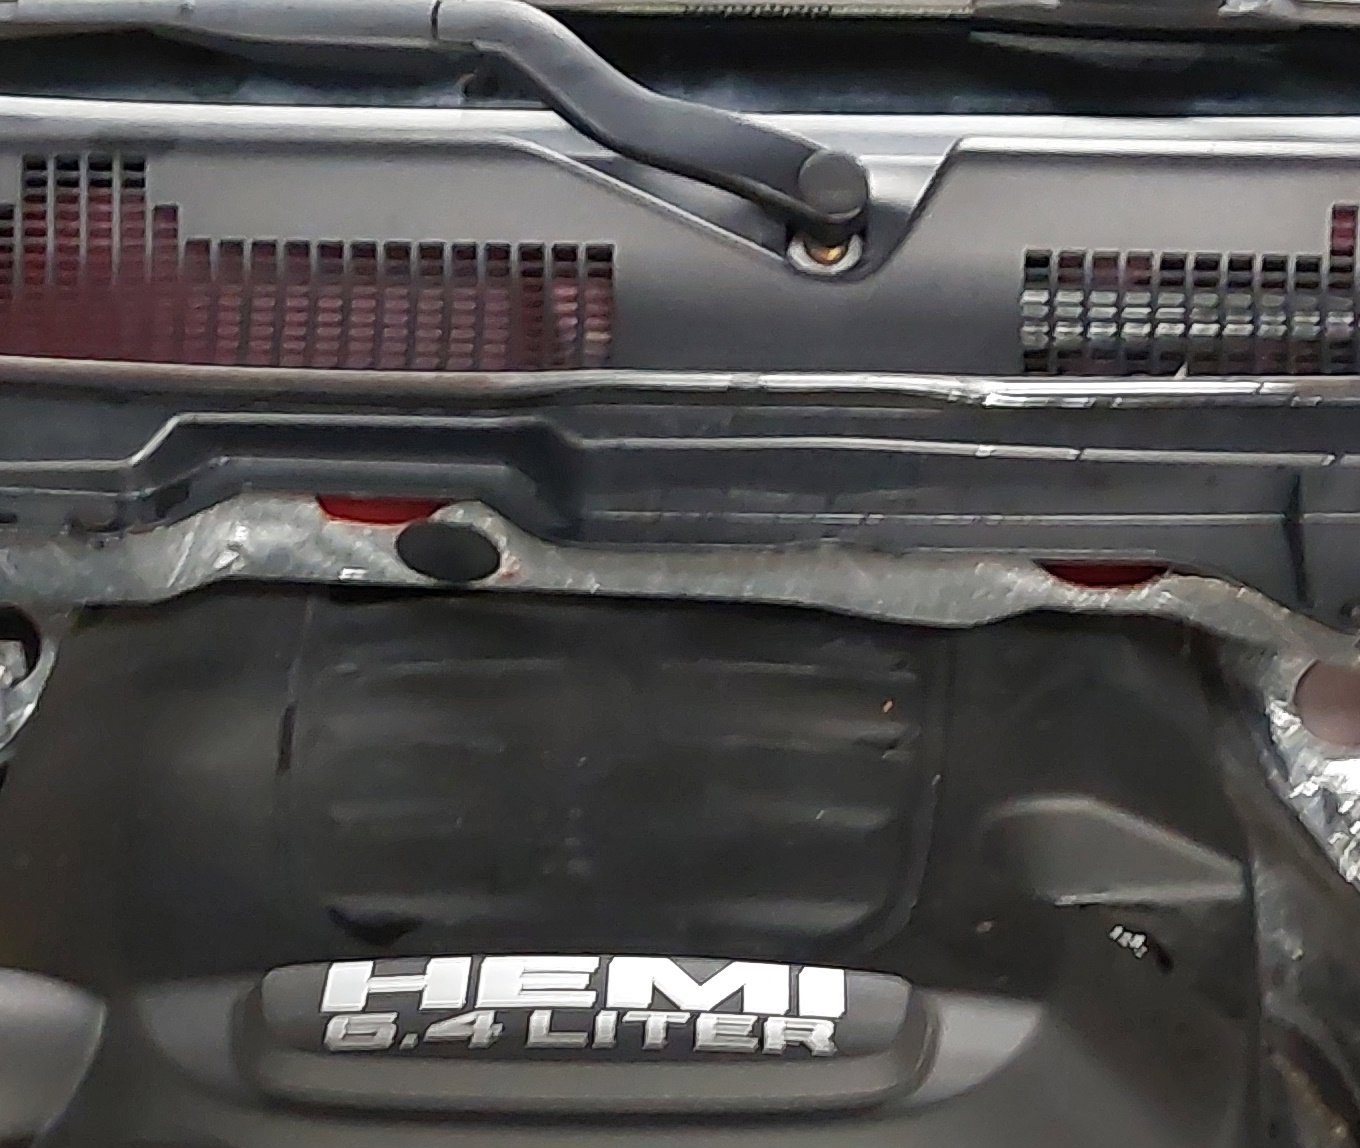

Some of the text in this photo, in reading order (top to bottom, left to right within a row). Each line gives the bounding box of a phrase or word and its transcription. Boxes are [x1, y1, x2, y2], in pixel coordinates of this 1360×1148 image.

[320, 955, 846, 1017] HEMI
[323, 1010, 837, 1056] 6.4 LITER
